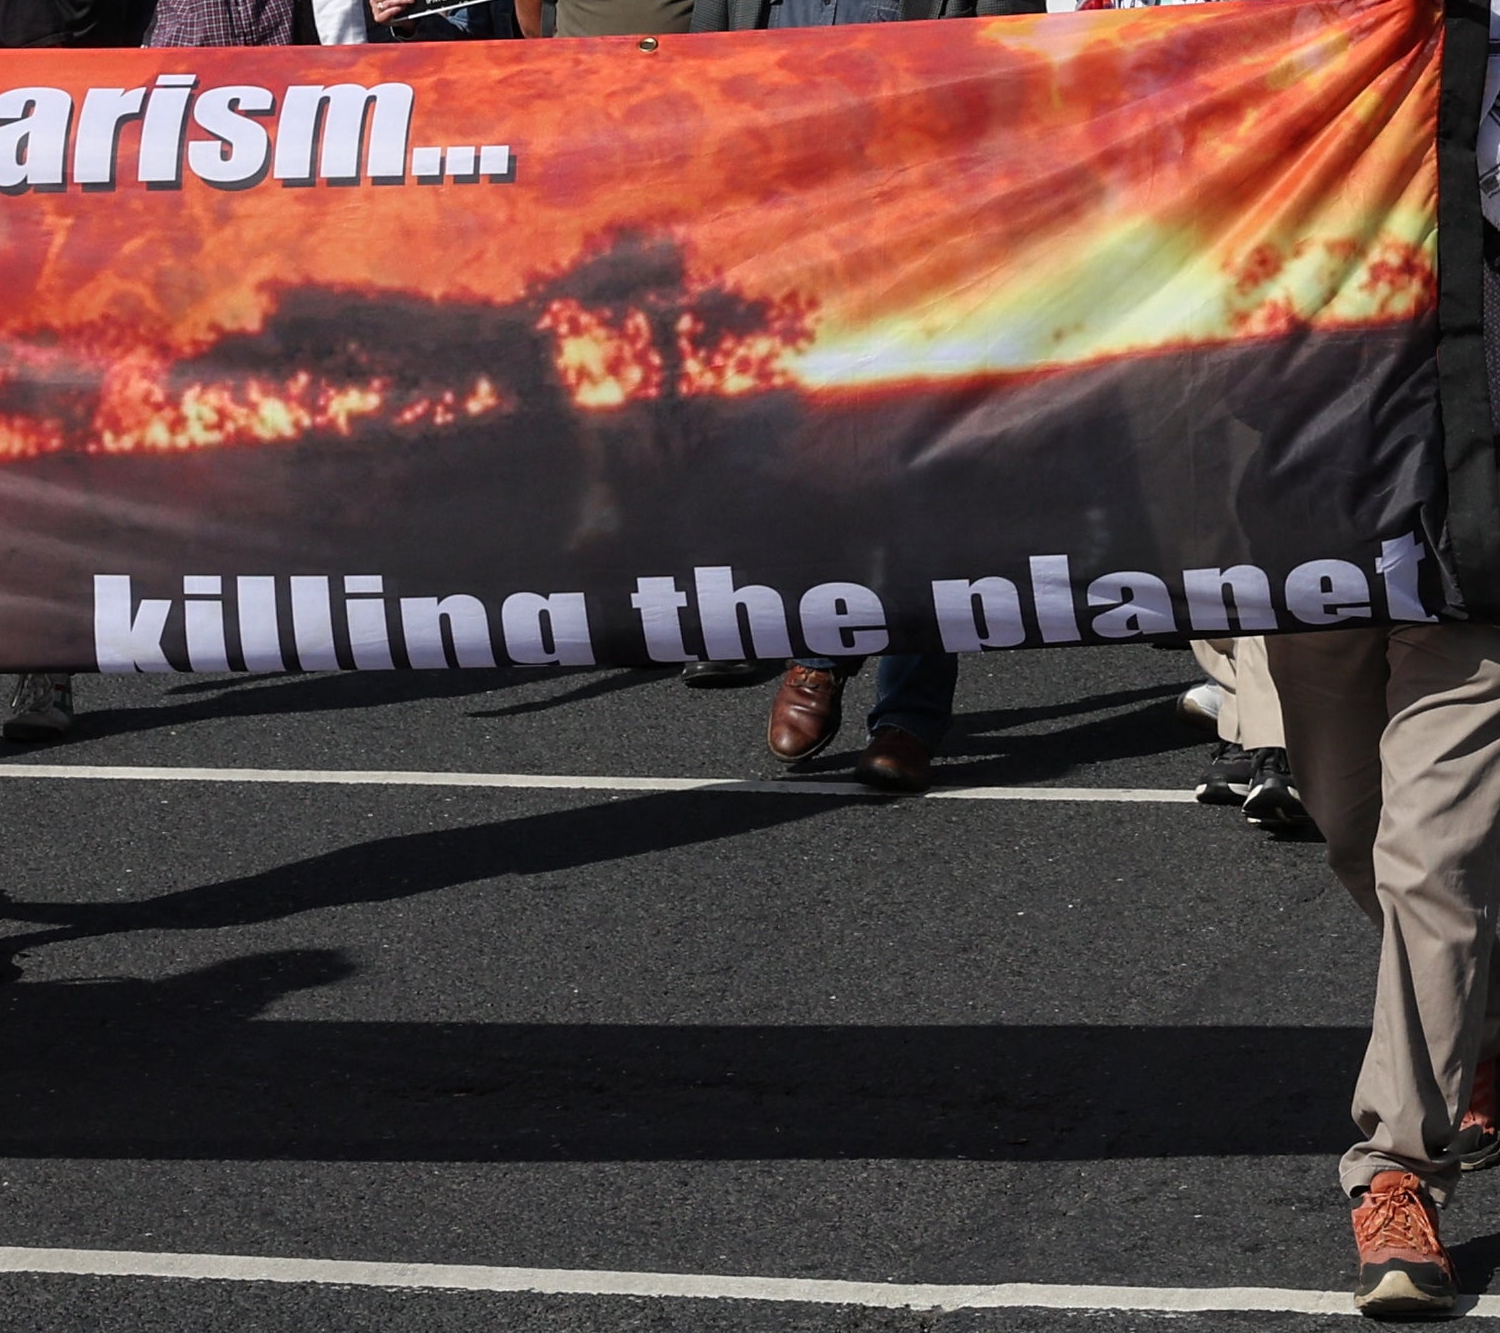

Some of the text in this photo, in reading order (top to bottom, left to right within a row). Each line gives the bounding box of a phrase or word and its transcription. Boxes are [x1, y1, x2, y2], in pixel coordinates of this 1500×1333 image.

[92, 533, 1442, 675] killing the planet
